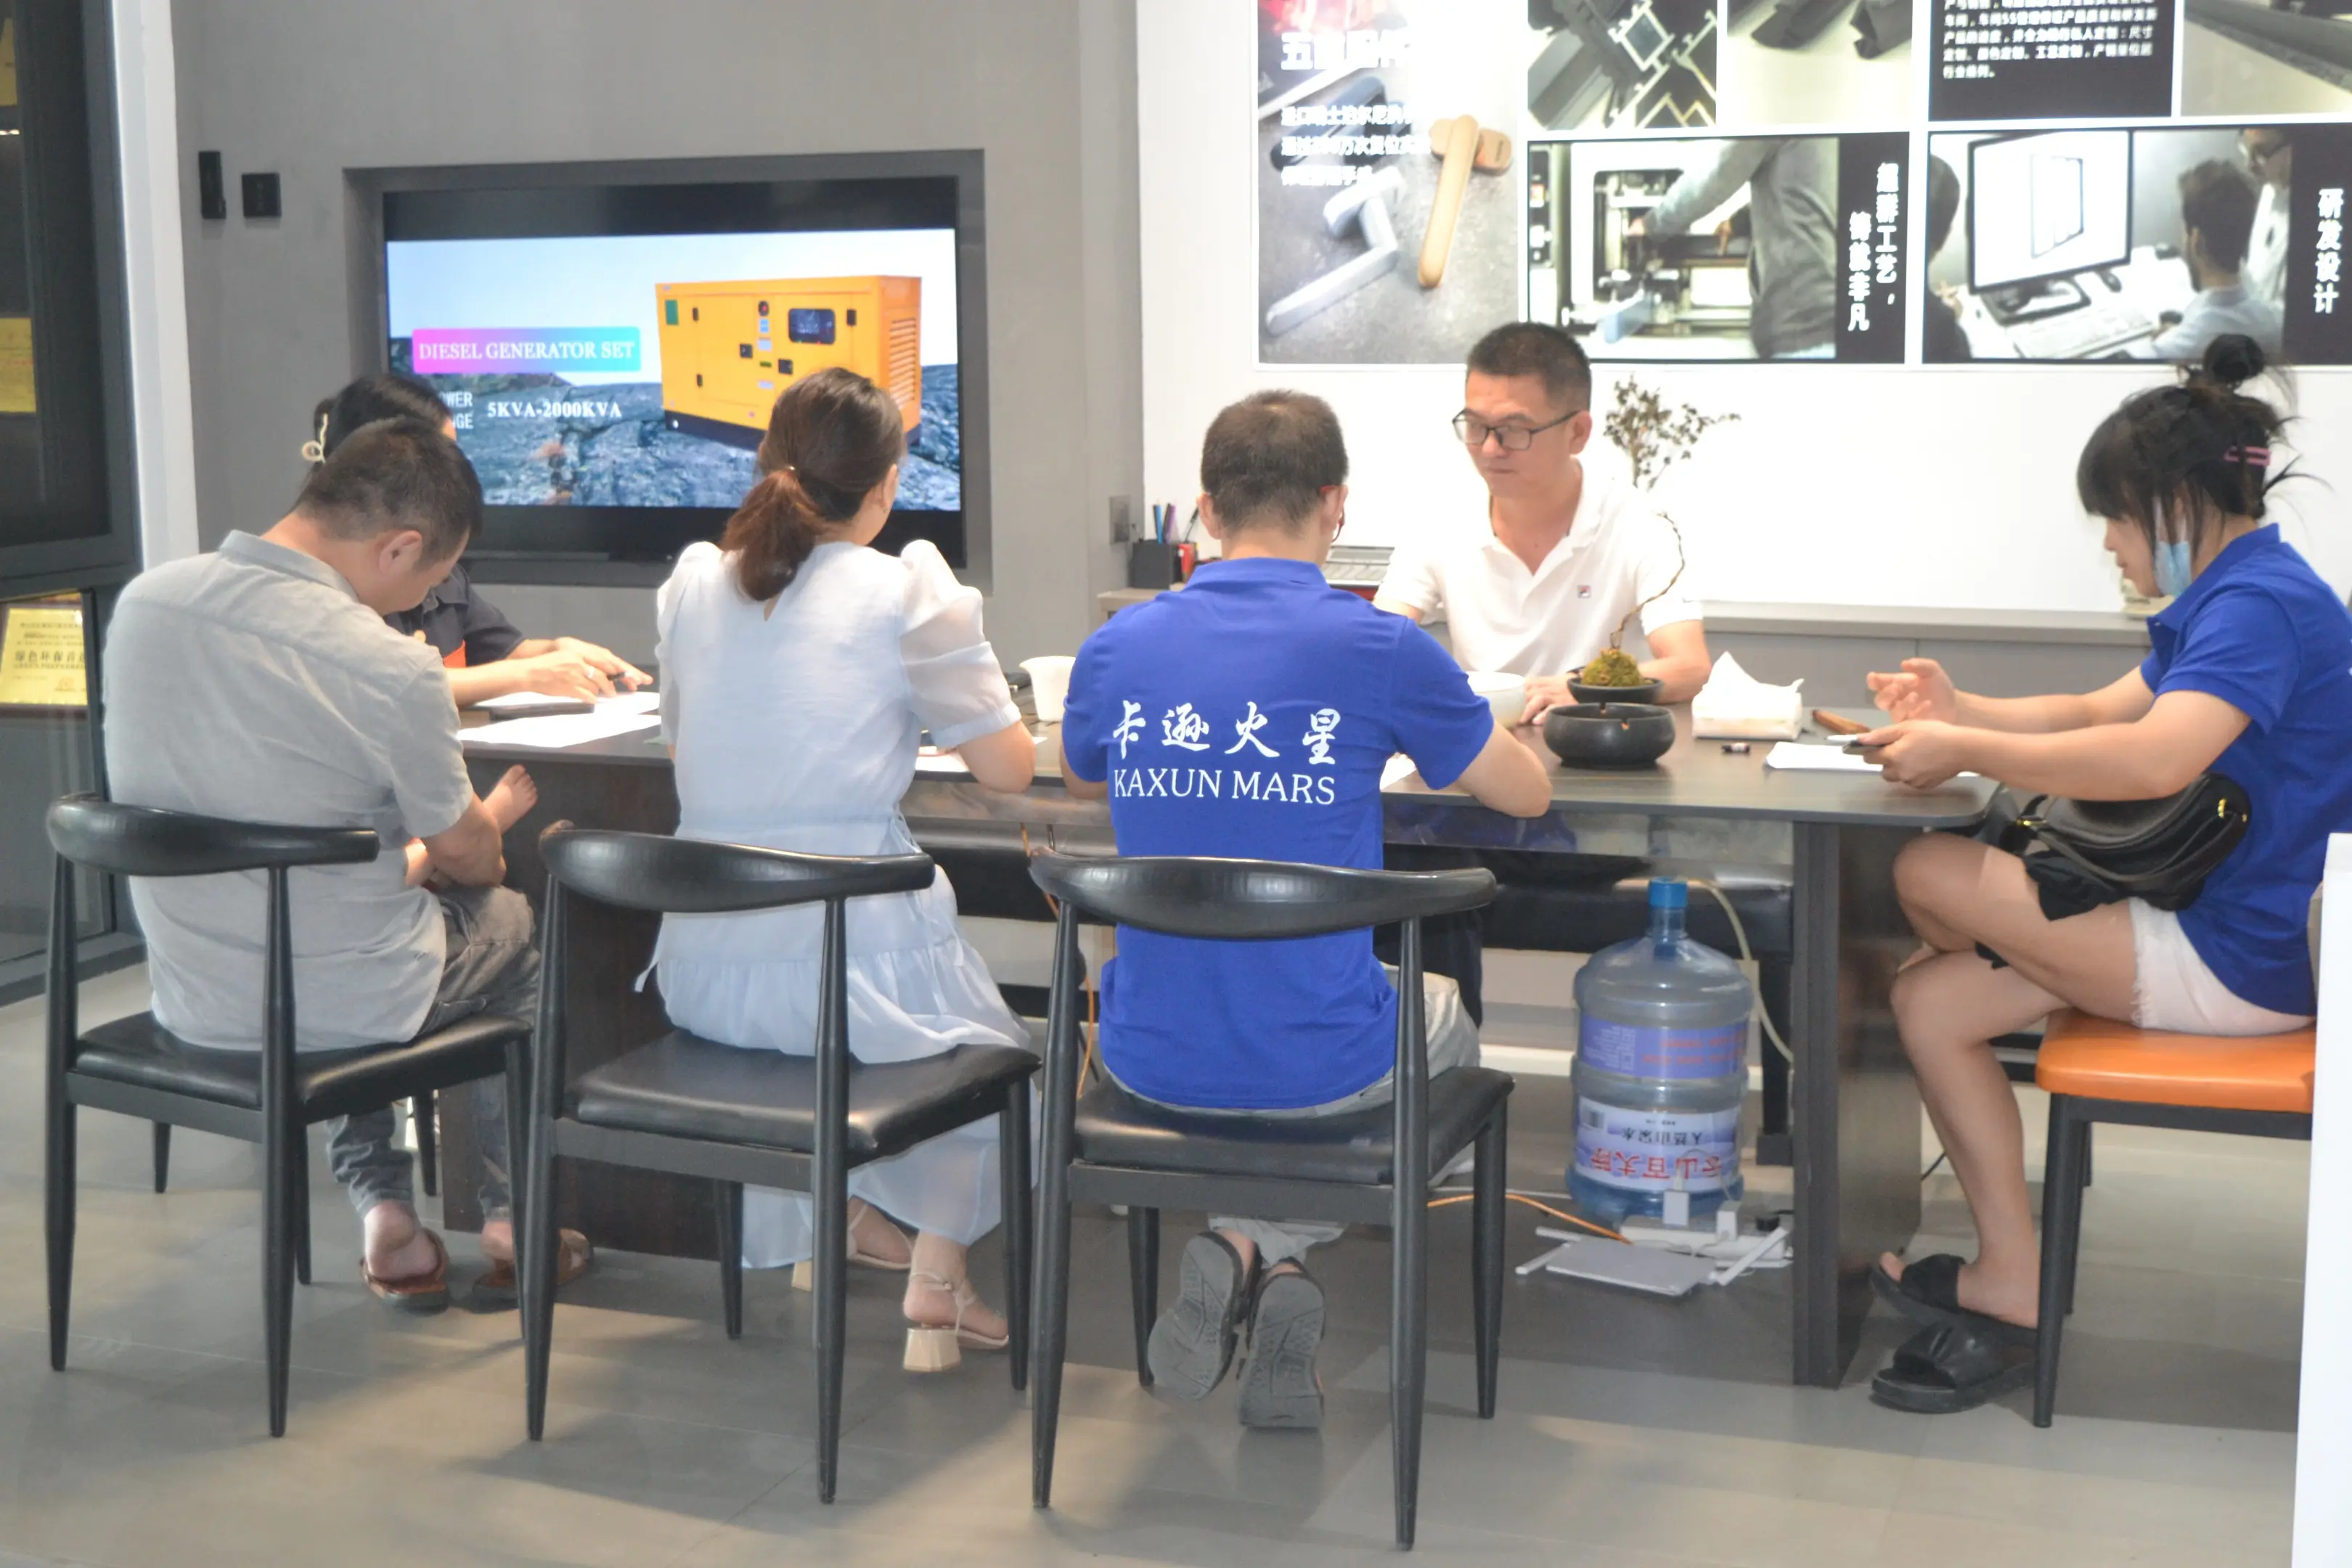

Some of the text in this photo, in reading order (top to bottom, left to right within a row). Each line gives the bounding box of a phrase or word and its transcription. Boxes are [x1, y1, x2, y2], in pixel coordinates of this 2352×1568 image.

[2313, 187, 2344, 314] 研发设计
[419, 341, 635, 360] DIESEL GENERATOR SET
[487, 401, 622, 419] 5KVA-2000KVA
[1114, 767, 1336, 806] KAXUN MARS
